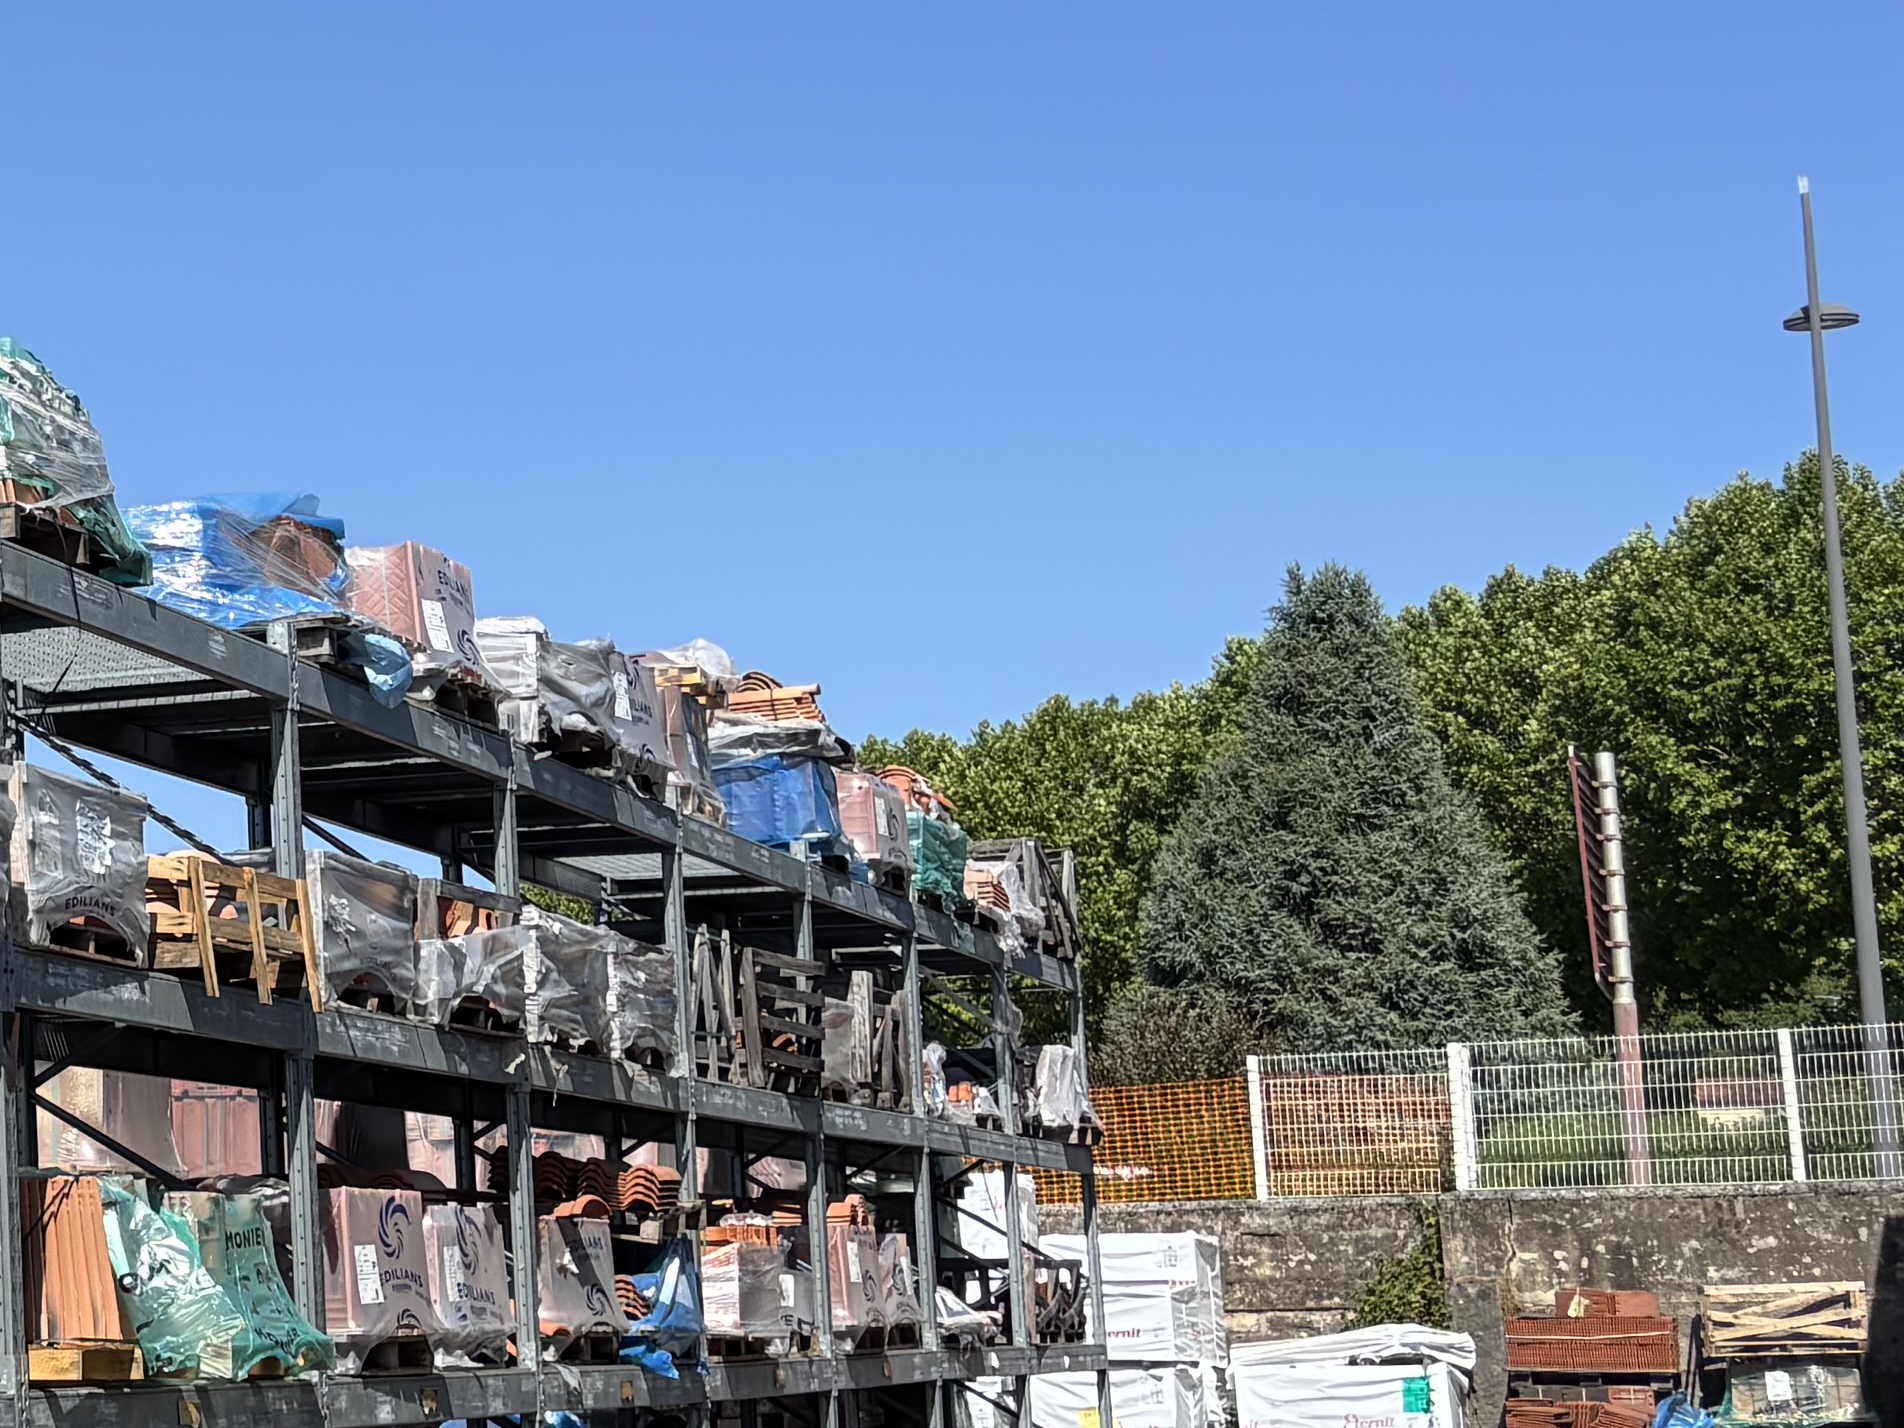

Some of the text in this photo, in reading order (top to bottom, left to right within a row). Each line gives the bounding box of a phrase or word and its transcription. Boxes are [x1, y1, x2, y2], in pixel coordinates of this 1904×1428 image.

[65, 897, 116, 918] EDILIANS
[225, 1228, 264, 1252] MONIE
[1106, 1328, 1142, 1339] ernit
